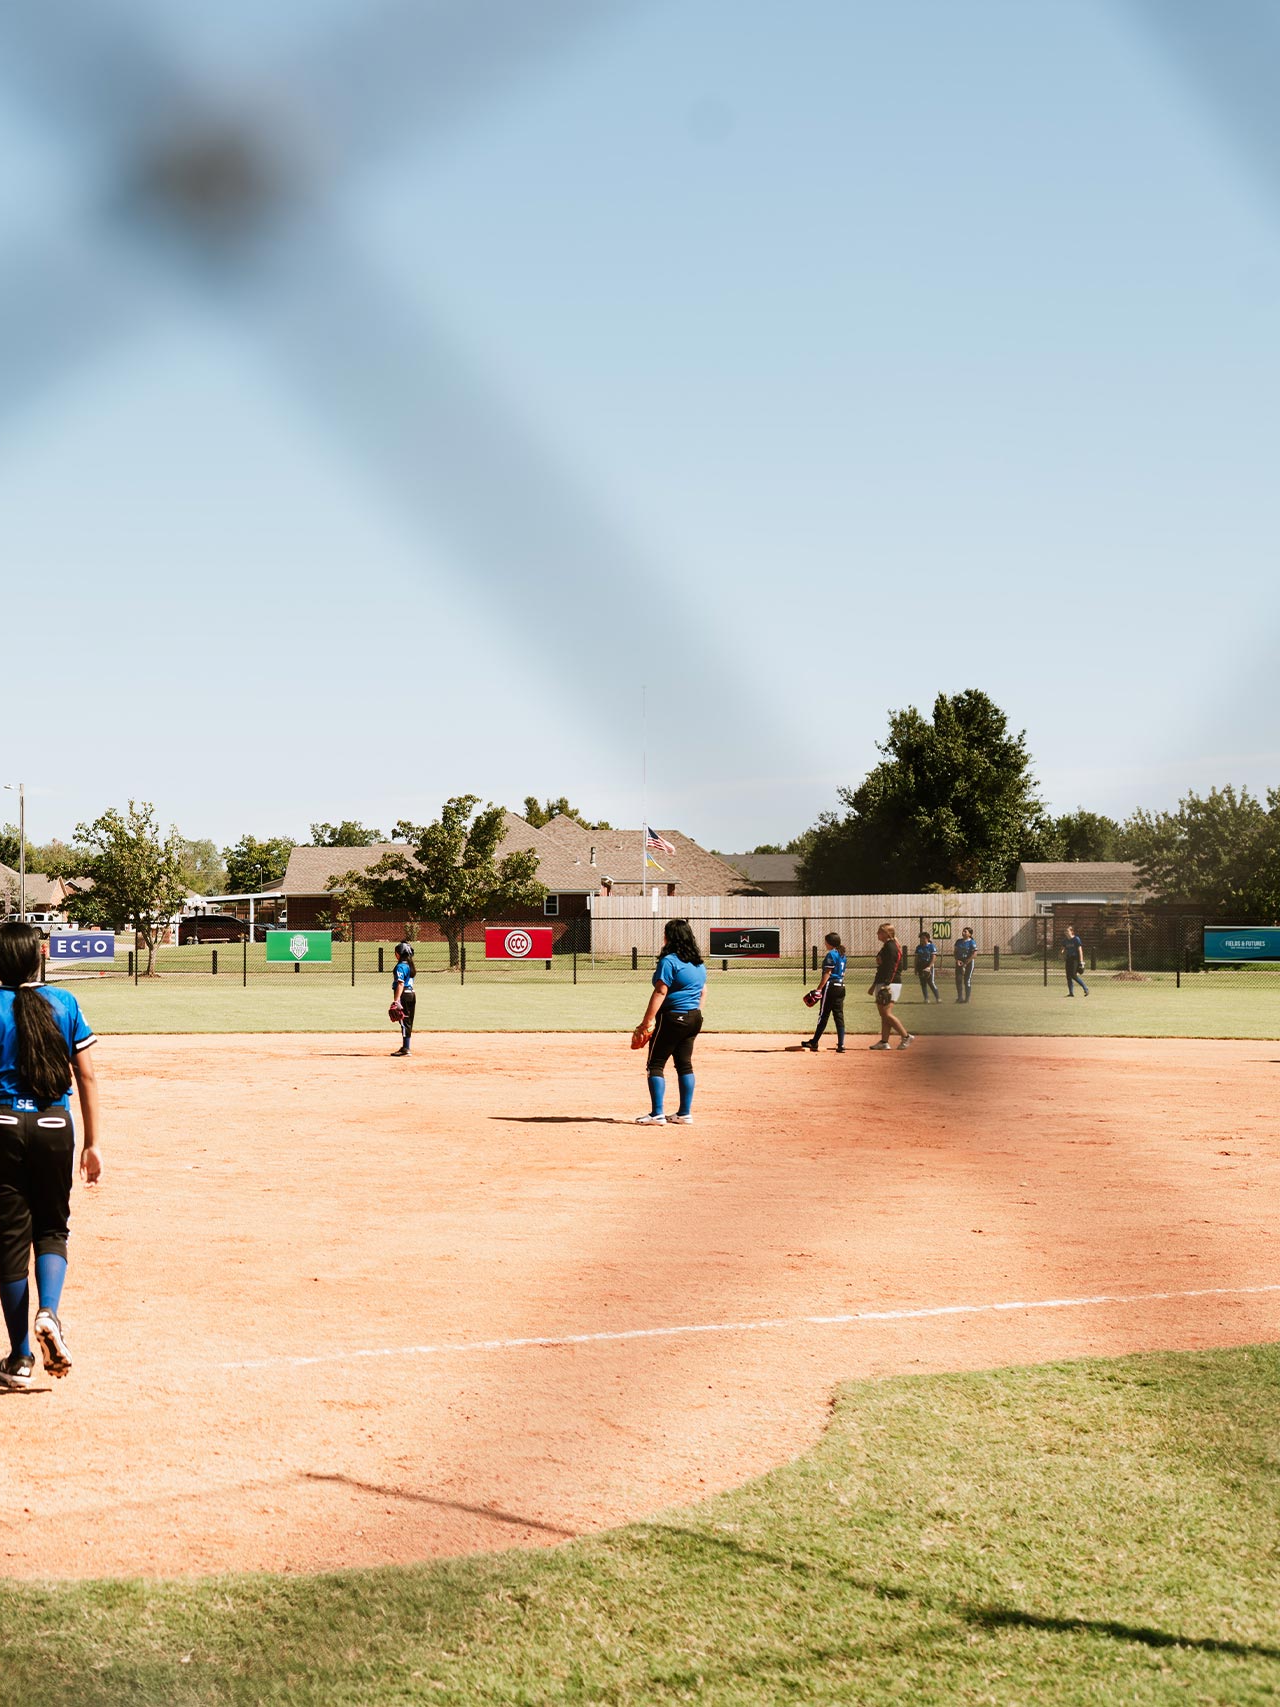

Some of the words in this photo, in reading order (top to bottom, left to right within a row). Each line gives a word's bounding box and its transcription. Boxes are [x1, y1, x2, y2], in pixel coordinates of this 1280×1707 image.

[933, 923, 951, 938] 200
[57, 940, 108, 953] ECHO
[510, 937, 525, 950] CCC
[17, 1099, 34, 1109] SE
